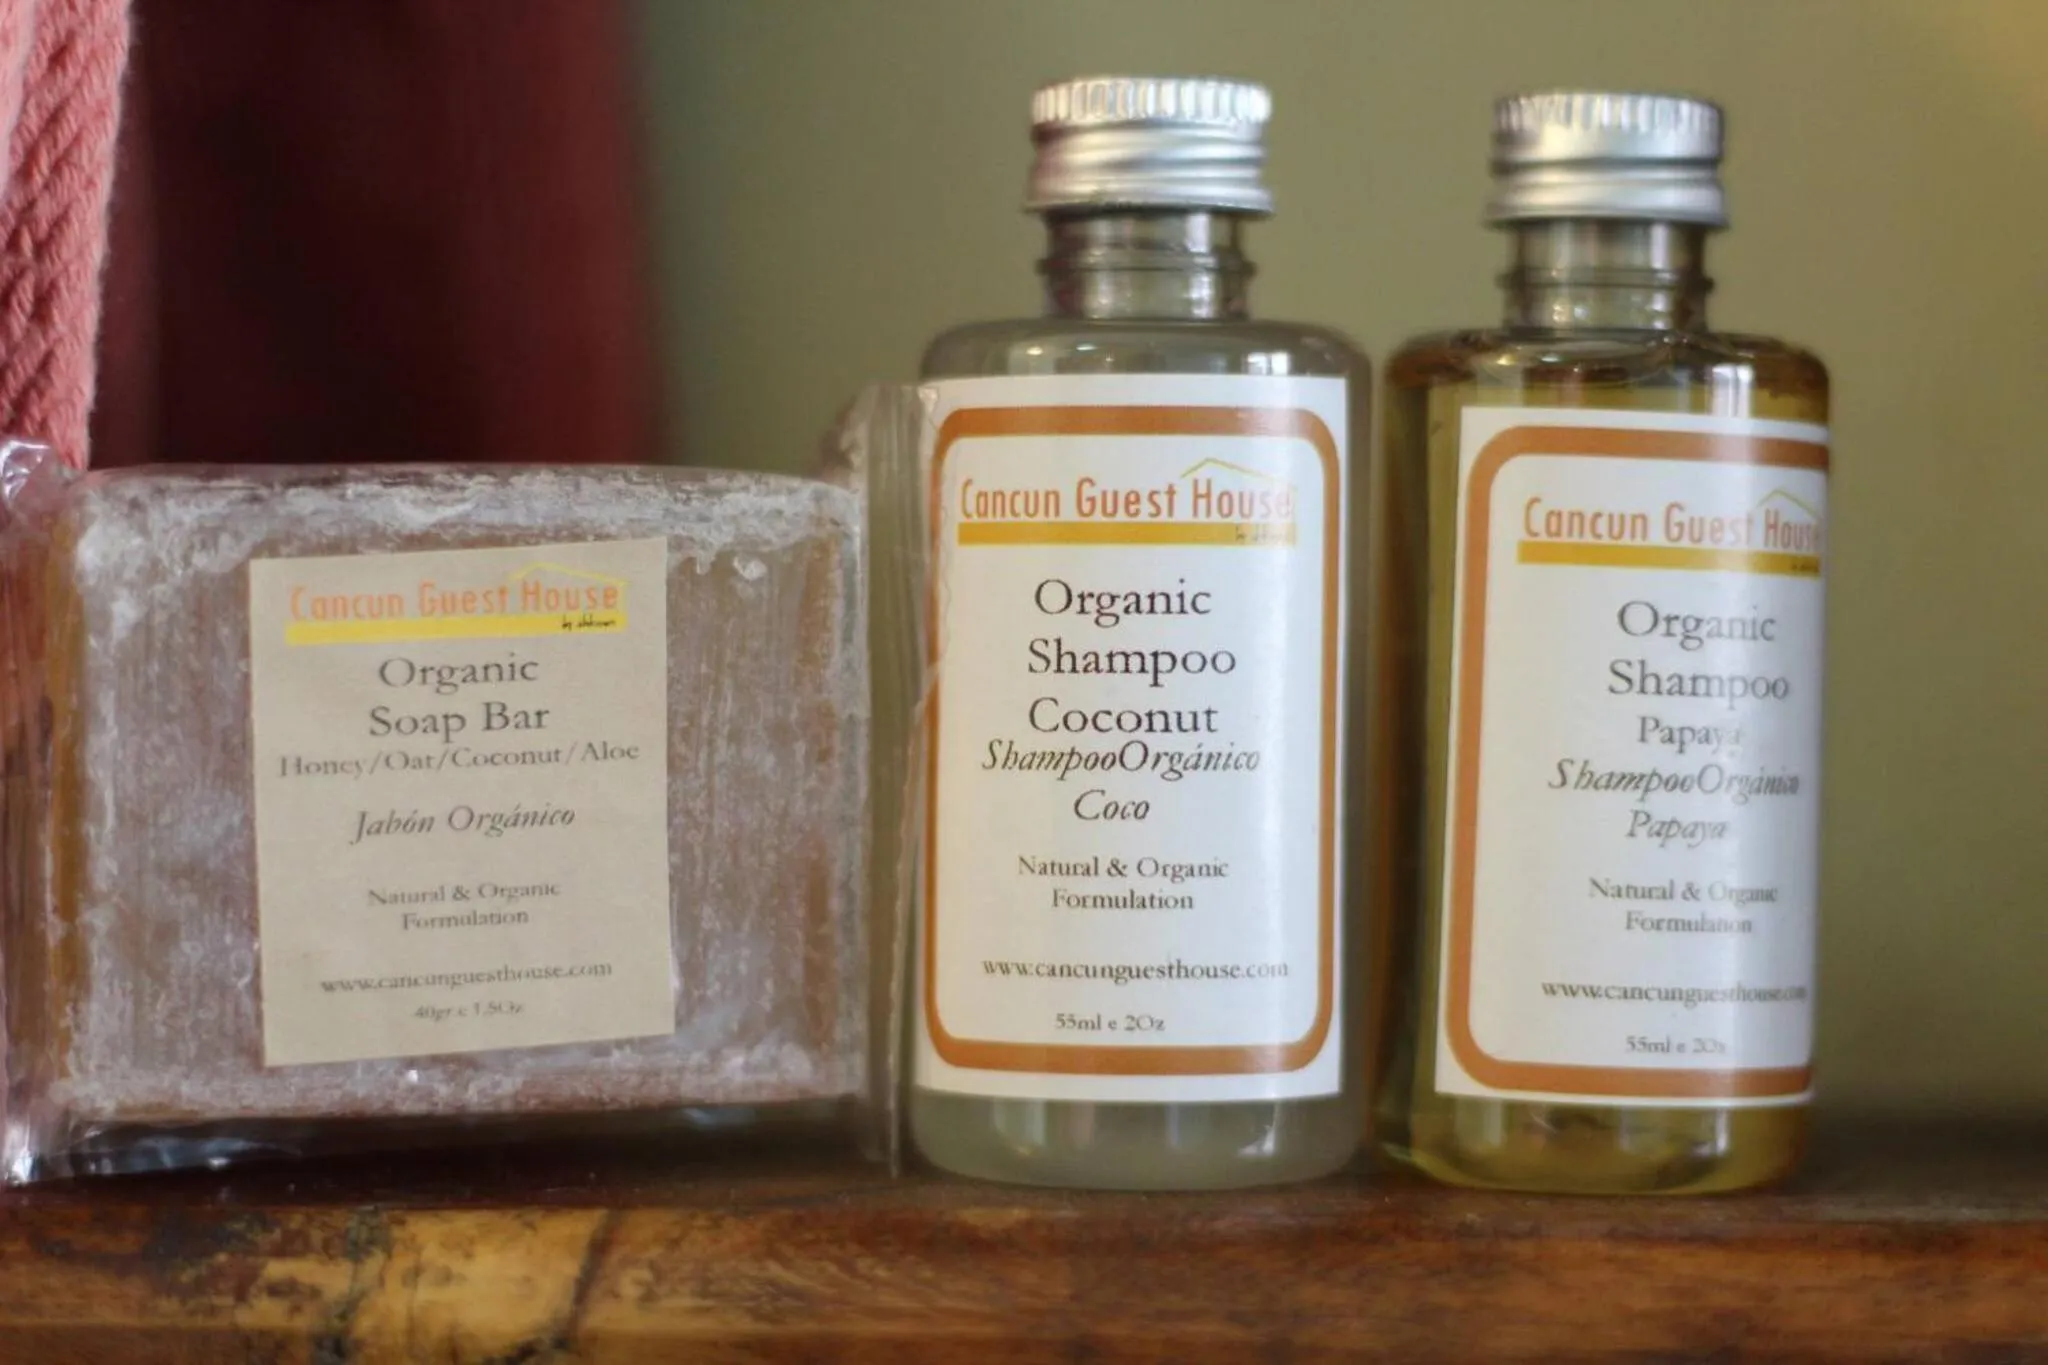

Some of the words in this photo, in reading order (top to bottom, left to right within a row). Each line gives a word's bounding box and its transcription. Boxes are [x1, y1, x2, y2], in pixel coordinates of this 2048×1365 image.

[960, 476, 1061, 520] Cancun
[1075, 476, 1177, 519] Guest
[1191, 477, 1292, 519] House
[1523, 496, 1649, 542] Cancun
[1663, 501, 1754, 547] Guest
[291, 585, 405, 622] Cancun
[418, 578, 511, 618] Guest
[521, 579, 619, 614] House
[1034, 577, 1213, 628] Organic
[1616, 599, 1777, 652] Organic
[378, 651, 539, 695] Organic
[1027, 636, 1237, 687] Shampoo
[1607, 657, 1790, 710] Shampoo
[368, 704, 467, 744] Soap
[483, 701, 551, 732] Bar
[1028, 696, 1219, 734] Coconut
[1637, 714, 1741, 755] Papaya
[349, 808, 435, 845] Jabón
[447, 802, 577, 838] Orgánico
[1072, 789, 1151, 821] Coco
[1626, 808, 1730, 848] Papaya
[1018, 855, 1099, 878] Natural
[1106, 858, 1127, 877] &
[1137, 855, 1230, 883] Organic
[367, 885, 446, 907] Natural
[452, 884, 471, 901] &
[479, 881, 562, 904] Organic
[1053, 888, 1194, 910] Formulation
[1588, 876, 1674, 901] Natural
[1680, 881, 1701, 901] &
[1708, 880, 1779, 906] Organic
[402, 909, 529, 931] Formulation
[1625, 909, 1753, 934] Formulation
[320, 961, 613, 995] www.cancunguesthouse.com
[982, 956, 1289, 985] www.cancunguesthouse.com
[1055, 1012, 1101, 1032] 55ml
[1124, 1013, 1166, 1032] 2Oz
[1625, 1035, 1670, 1054] 55ml
